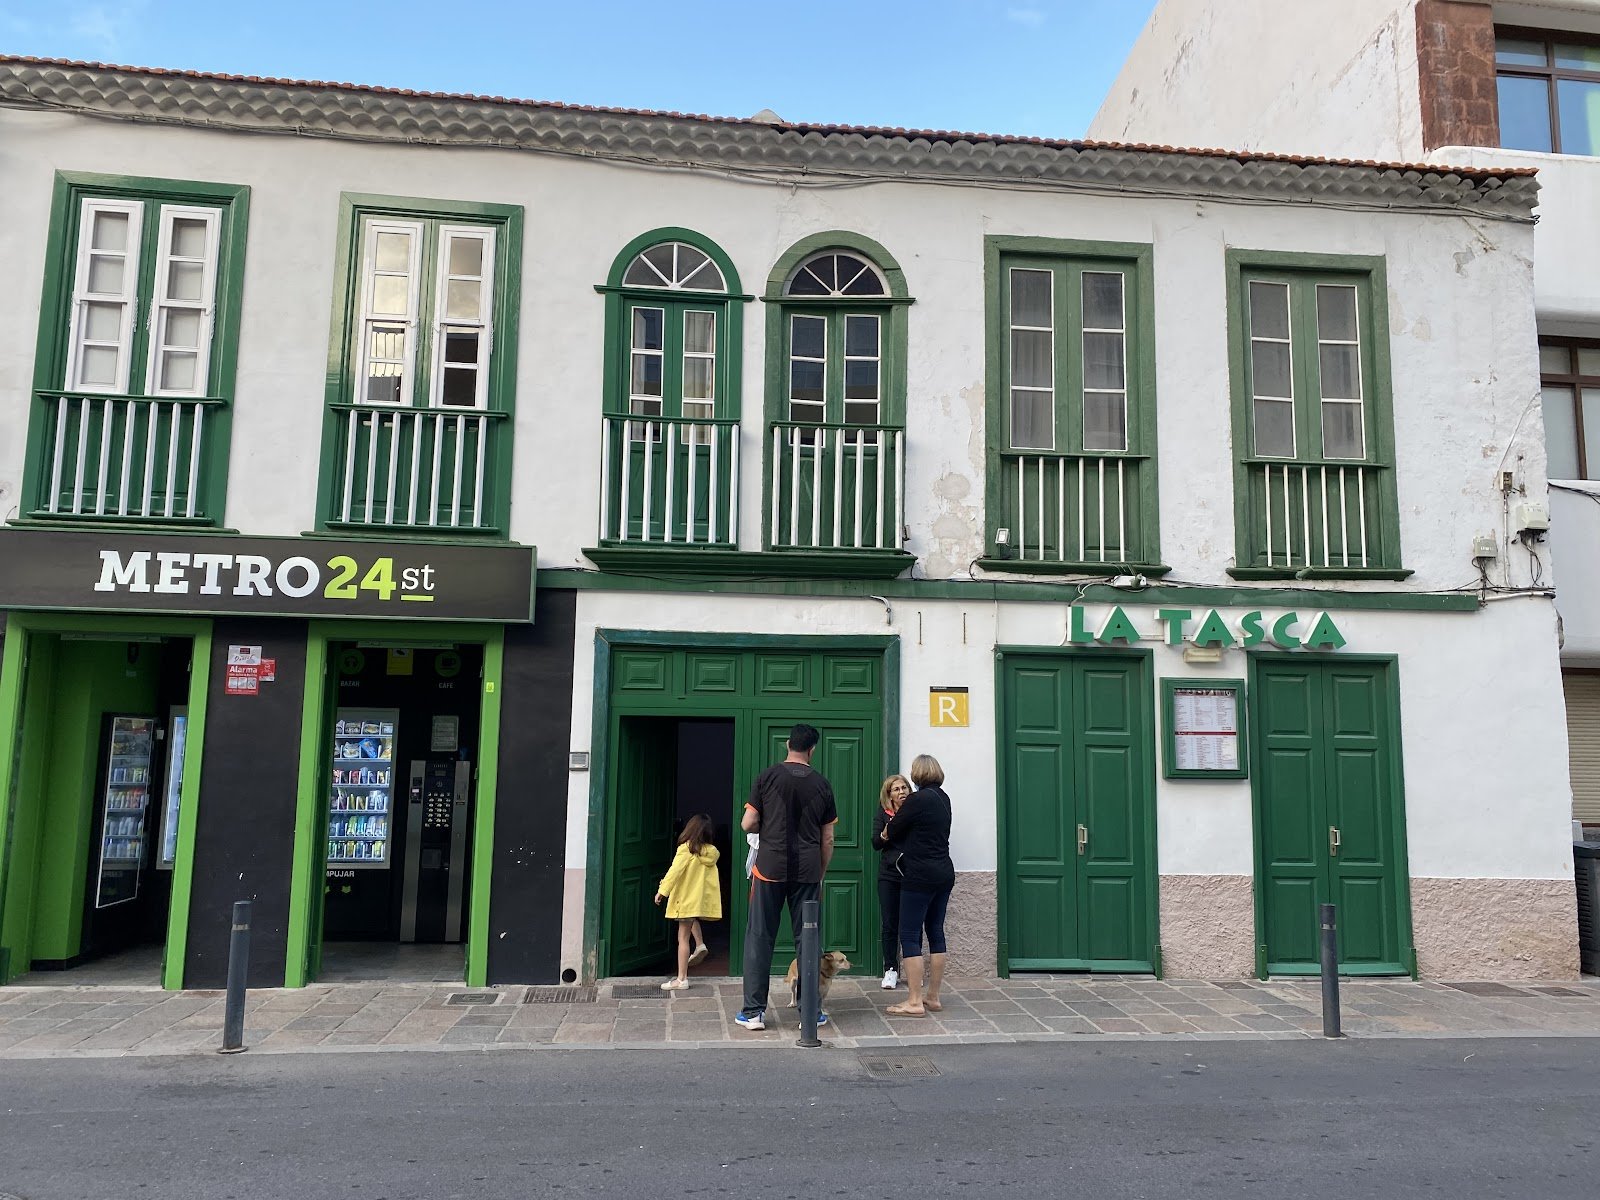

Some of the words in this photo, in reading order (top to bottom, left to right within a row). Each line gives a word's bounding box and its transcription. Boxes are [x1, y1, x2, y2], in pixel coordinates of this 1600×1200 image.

[1067, 605, 1141, 645] LA
[1154, 608, 1347, 649] TASCA
[229, 665, 258, 674] Alarma
[938, 696, 960, 723] R
